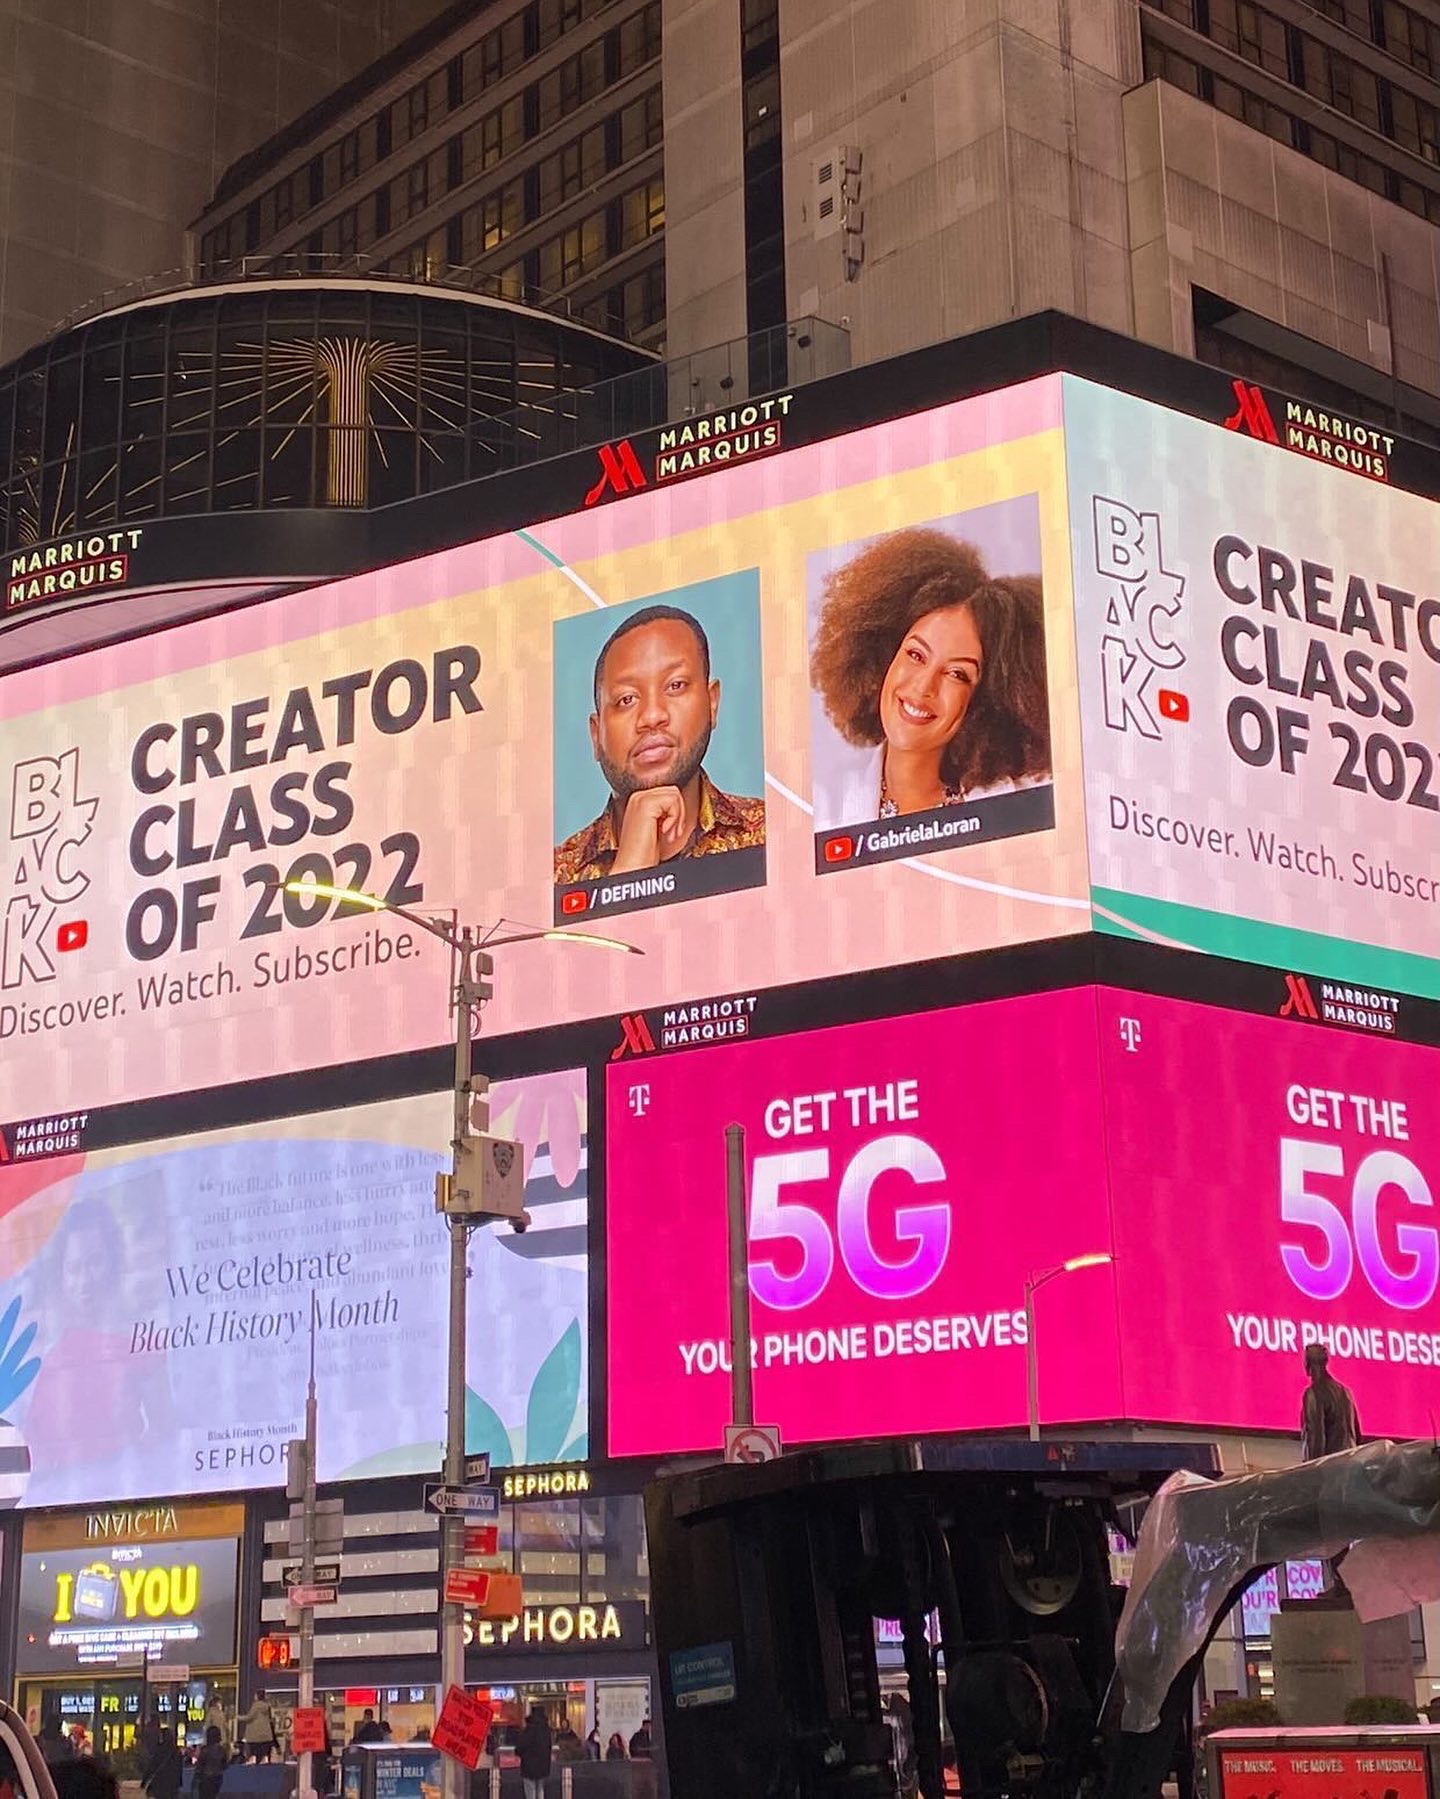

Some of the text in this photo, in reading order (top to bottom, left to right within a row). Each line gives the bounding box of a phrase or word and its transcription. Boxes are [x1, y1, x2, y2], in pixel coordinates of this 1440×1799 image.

[660, 395, 793, 451] MARRIOTT
[1286, 401, 1394, 456] MARRIOTT
[660, 427, 776, 477] MARQUIS
[1288, 426, 1385, 477] MARQUIS
[11, 529, 142, 577] MARRIOTT
[10, 560, 124, 604] MARQUIS
[1221, 614, 1414, 728] CLASS
[130, 645, 483, 794] CREATOR
[1226, 695, 1440, 813] OF 202
[129, 761, 354, 876] CLASS
[867, 815, 980, 852] GabrielaLoran
[1108, 794, 1440, 903] Discover. Watch. Subscr
[125, 832, 423, 961] OF 2022
[600, 874, 675, 905] DEFINING
[0, 930, 421, 1039] Discover. Watch. Subscribe.
[1322, 983, 1399, 1012] MARRIOTT
[664, 997, 757, 1026] MARRIOTT
[664, 1018, 746, 1046] MARQUIS
[1324, 1003, 1394, 1031] MARQUIS
[16, 1115, 88, 1139] MARRIOTT
[765, 1080, 919, 1138] GET THE
[1287, 1084, 1409, 1140] GET THE
[16, 1134, 78, 1156] MARQUIS
[747, 1134, 951, 1311] 5G
[1280, 1138, 1440, 1310] 5G
[166, 1266, 210, 1298] We
[217, 1252, 352, 1291] Celebrate
[130, 1315, 199, 1355] Black
[205, 1308, 302, 1345] History
[308, 1290, 399, 1332] Month
[764, 1326, 867, 1367] PHONE
[874, 1311, 1028, 1357] DESERVES
[1226, 1313, 1440, 1367] YOUR PHONE DESE
[195, 1443, 289, 1471] SEPHOR
[436, 1493, 490, 1507] ONE WAY
[504, 1471, 590, 1498] SEPHORA
[86, 1506, 179, 1539] INVICTA
[54, 1563, 198, 1621] I YOU
[1288, 1566, 1322, 1584] COV
[464, 1605, 621, 1646] SEPHORA
[1356, 1759, 1375, 1773] THE
